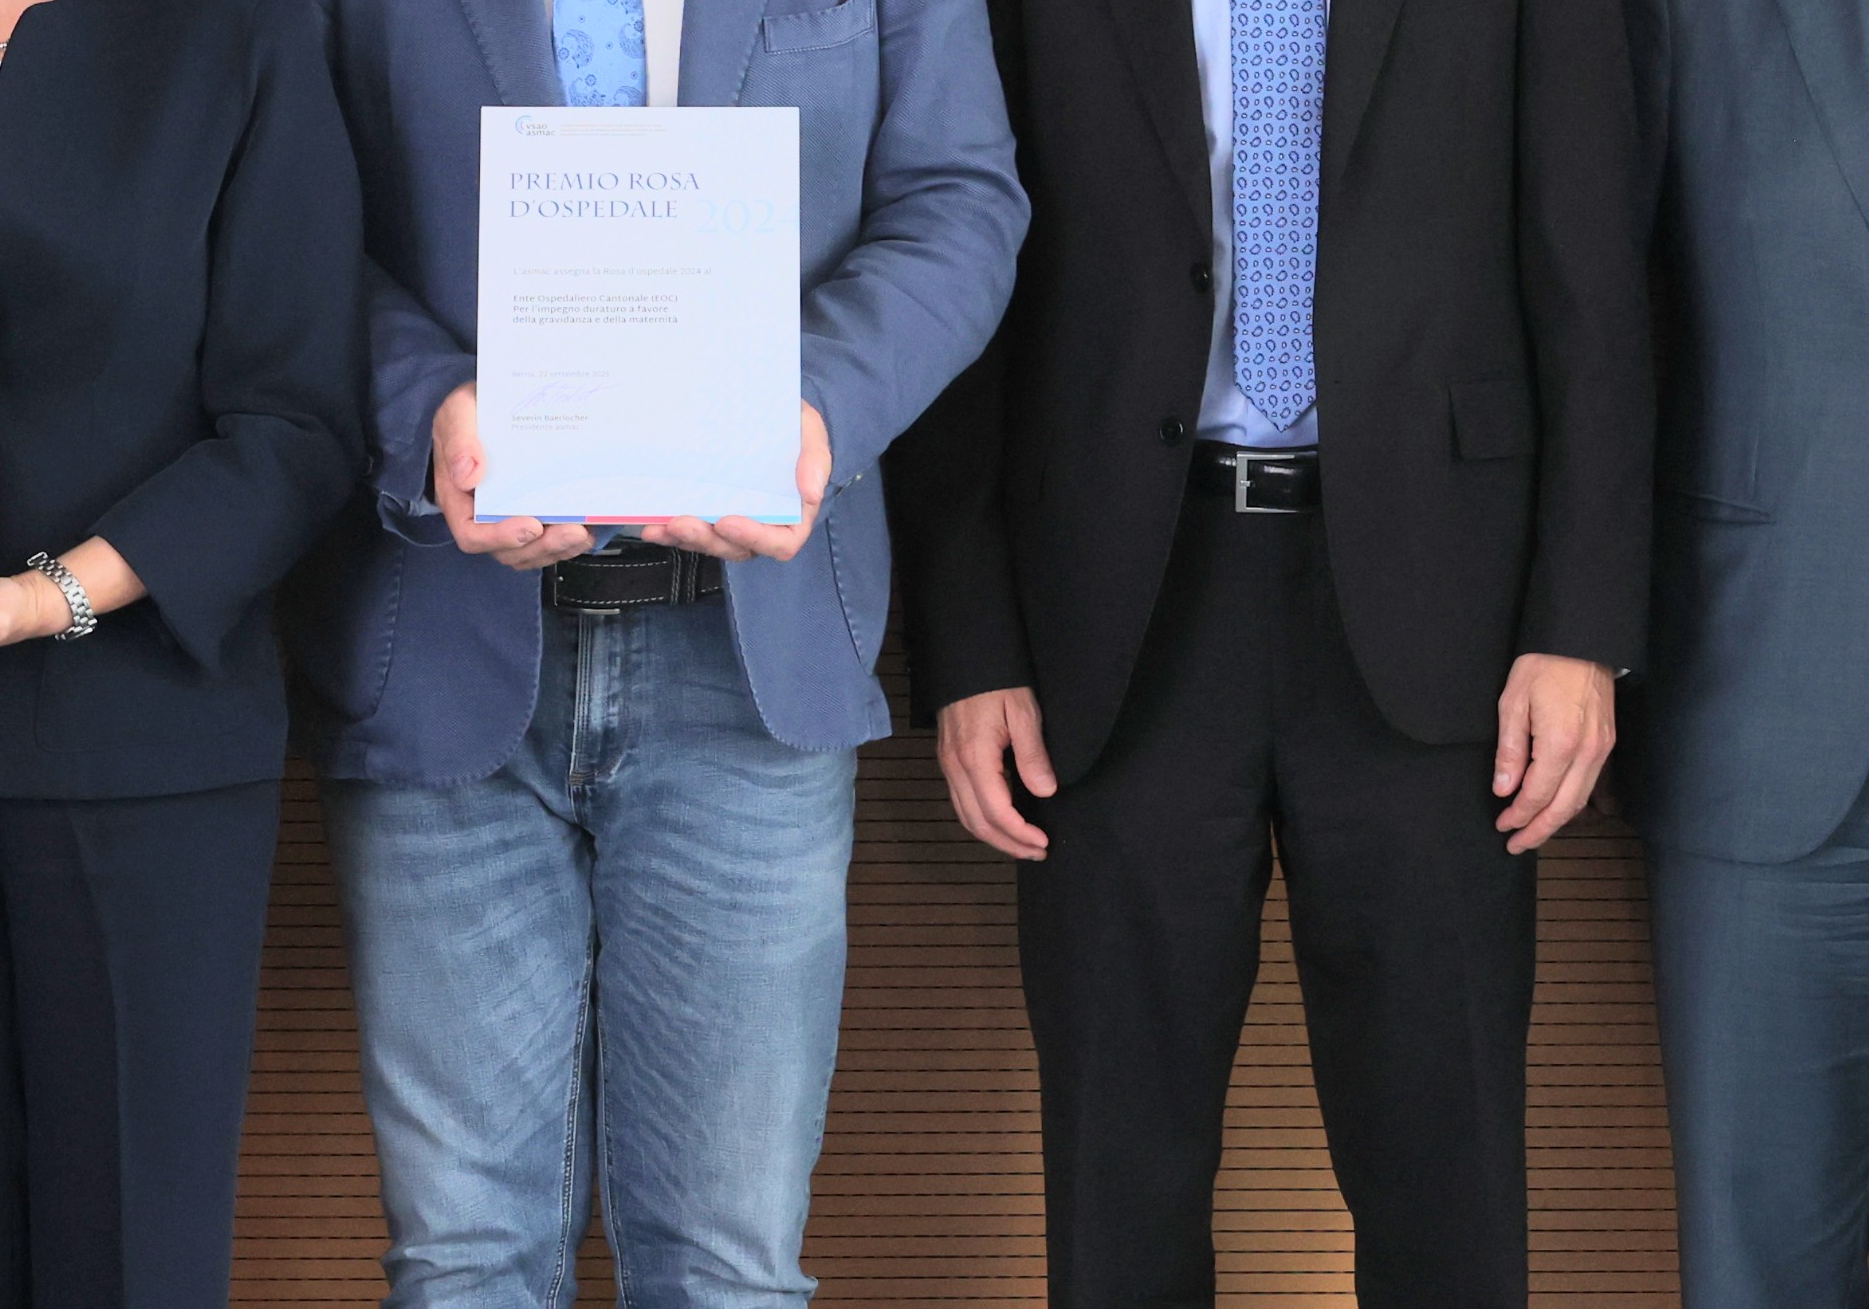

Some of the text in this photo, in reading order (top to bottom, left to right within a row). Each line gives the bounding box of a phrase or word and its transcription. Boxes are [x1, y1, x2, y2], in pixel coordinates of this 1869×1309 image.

[509, 172, 701, 191] PREMIO ROSA
[508, 200, 678, 219] D'OSPEDALE
[553, 268, 590, 277] assegna
[592, 267, 601, 275] la
[603, 267, 626, 275] Rosa
[680, 267, 701, 275] 2024
[703, 267, 712, 275] al
[513, 294, 678, 304] Ente Ospedaliero Cantonale (EOC)
[513, 305, 529, 313] Per
[531, 305, 581, 315] l'impegno
[583, 305, 627, 313] duraturo
[637, 305, 669, 313] favore
[512, 315, 536, 323] della
[539, 315, 592, 326] gravidanza
[603, 315, 627, 323] della
[629, 315, 678, 323] maternità
